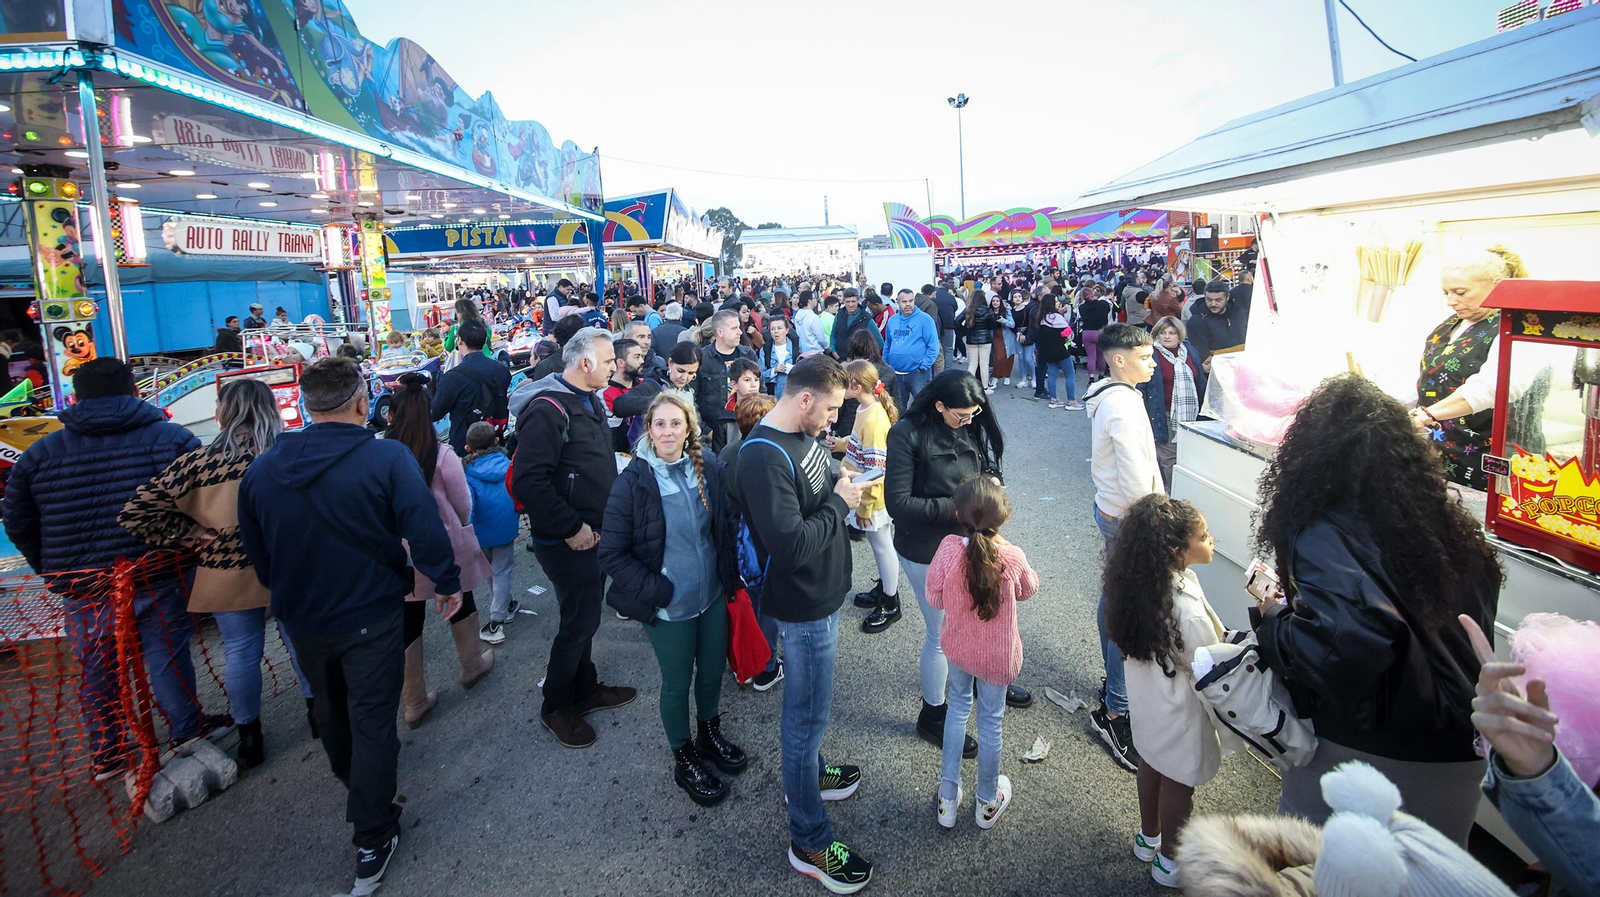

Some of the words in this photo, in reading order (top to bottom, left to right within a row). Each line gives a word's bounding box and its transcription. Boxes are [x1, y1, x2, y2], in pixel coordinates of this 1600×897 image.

[186, 226, 223, 250] AUTO
[232, 229, 270, 251] RALLY
[445, 226, 508, 247] PISTA
